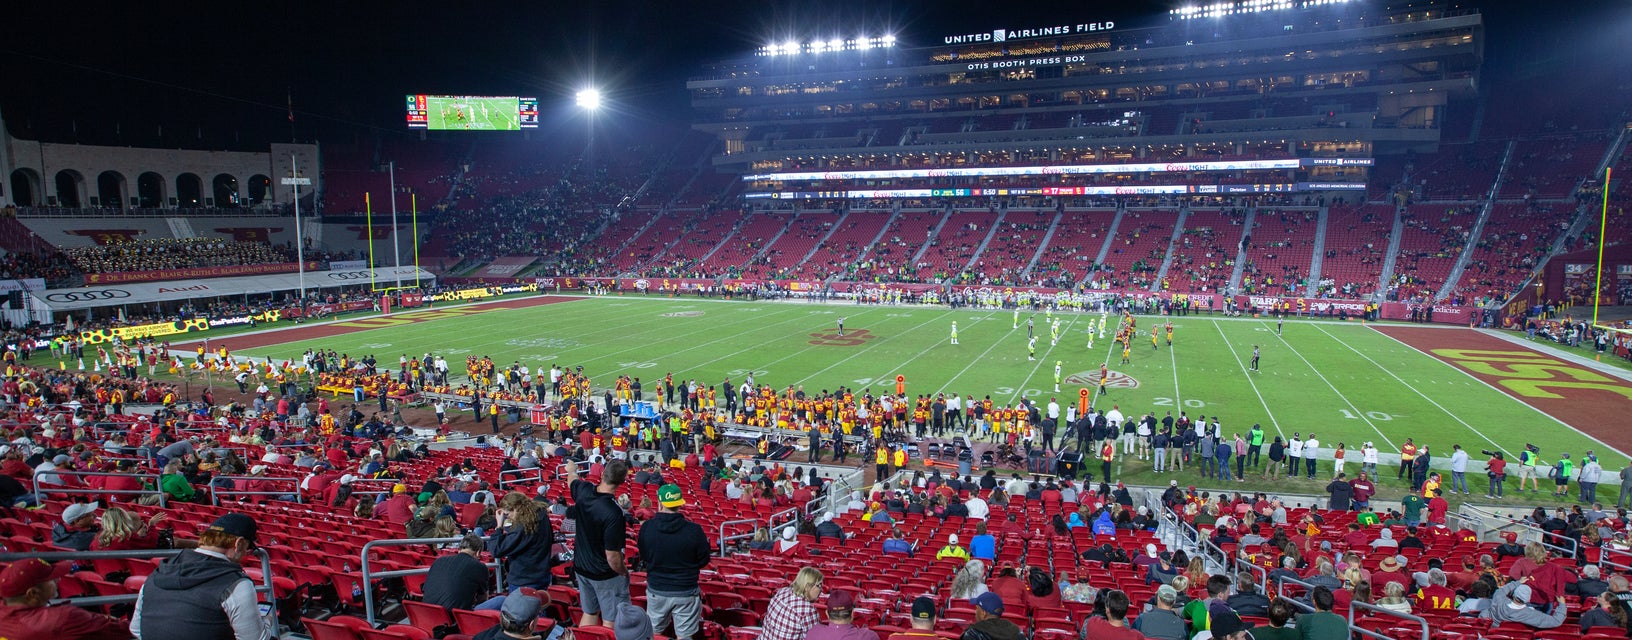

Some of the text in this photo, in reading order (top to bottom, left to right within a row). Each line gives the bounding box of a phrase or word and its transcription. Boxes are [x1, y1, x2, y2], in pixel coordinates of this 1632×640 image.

[945, 21, 1115, 44] UNITED AIRLINES FIELD
[1030, 57, 1061, 65] PRESS
[1568, 264, 1582, 272] 34
[158, 284, 209, 294] Audi
[209, 314, 264, 326] theParkingSot
[852, 377, 897, 386] 40
[994, 386, 1042, 396] 30
[1153, 397, 1206, 408] 20
[1338, 408, 1393, 421] 10
[613, 438, 622, 446] 55
[1432, 596, 1451, 609] 14
